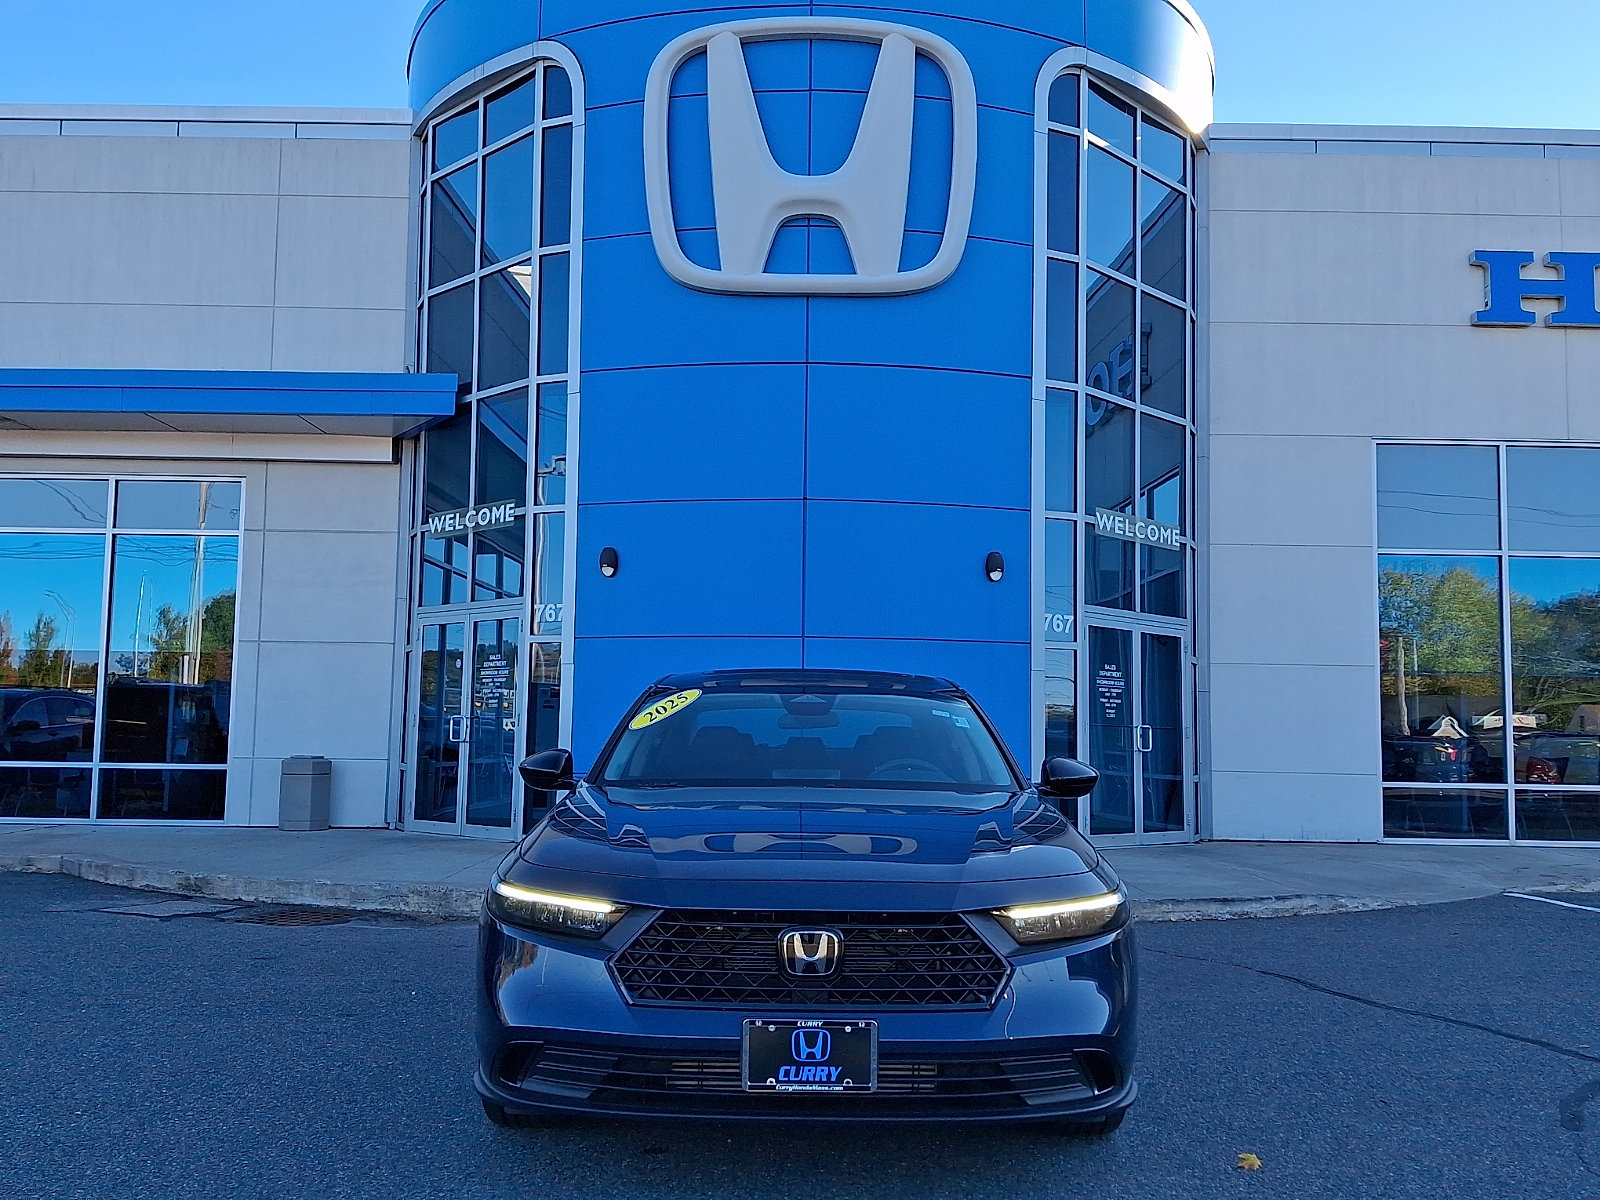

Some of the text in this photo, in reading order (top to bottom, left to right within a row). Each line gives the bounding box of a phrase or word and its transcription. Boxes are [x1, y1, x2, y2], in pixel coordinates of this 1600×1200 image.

[428, 503, 516, 534] WELCOME
[1096, 511, 1181, 547] WELCOME
[534, 603, 563, 622] 767
[1045, 613, 1075, 634] 767
[643, 693, 689, 722] 2025
[778, 1065, 843, 1082] CURRY
